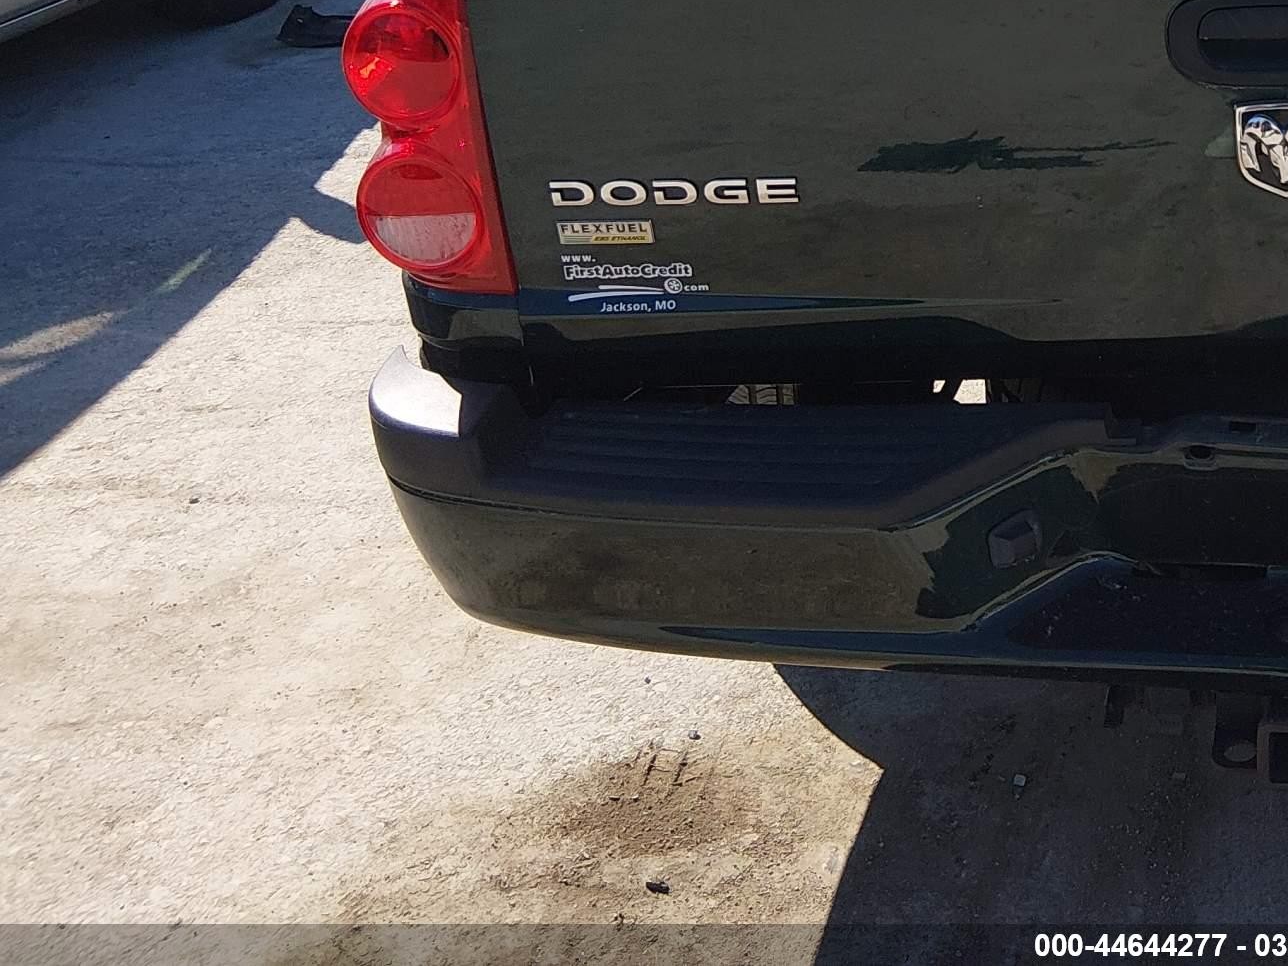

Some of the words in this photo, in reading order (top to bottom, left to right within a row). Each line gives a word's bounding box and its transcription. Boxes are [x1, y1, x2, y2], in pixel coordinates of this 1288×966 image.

[549, 177, 800, 207] DODGE
[560, 223, 648, 234] FLEXFUEL
[560, 254, 597, 263] www.
[564, 263, 693, 281] FirstAutoCredit
[683, 282, 710, 292] com
[600, 301, 652, 313] Jackson,
[655, 300, 677, 311] MO
